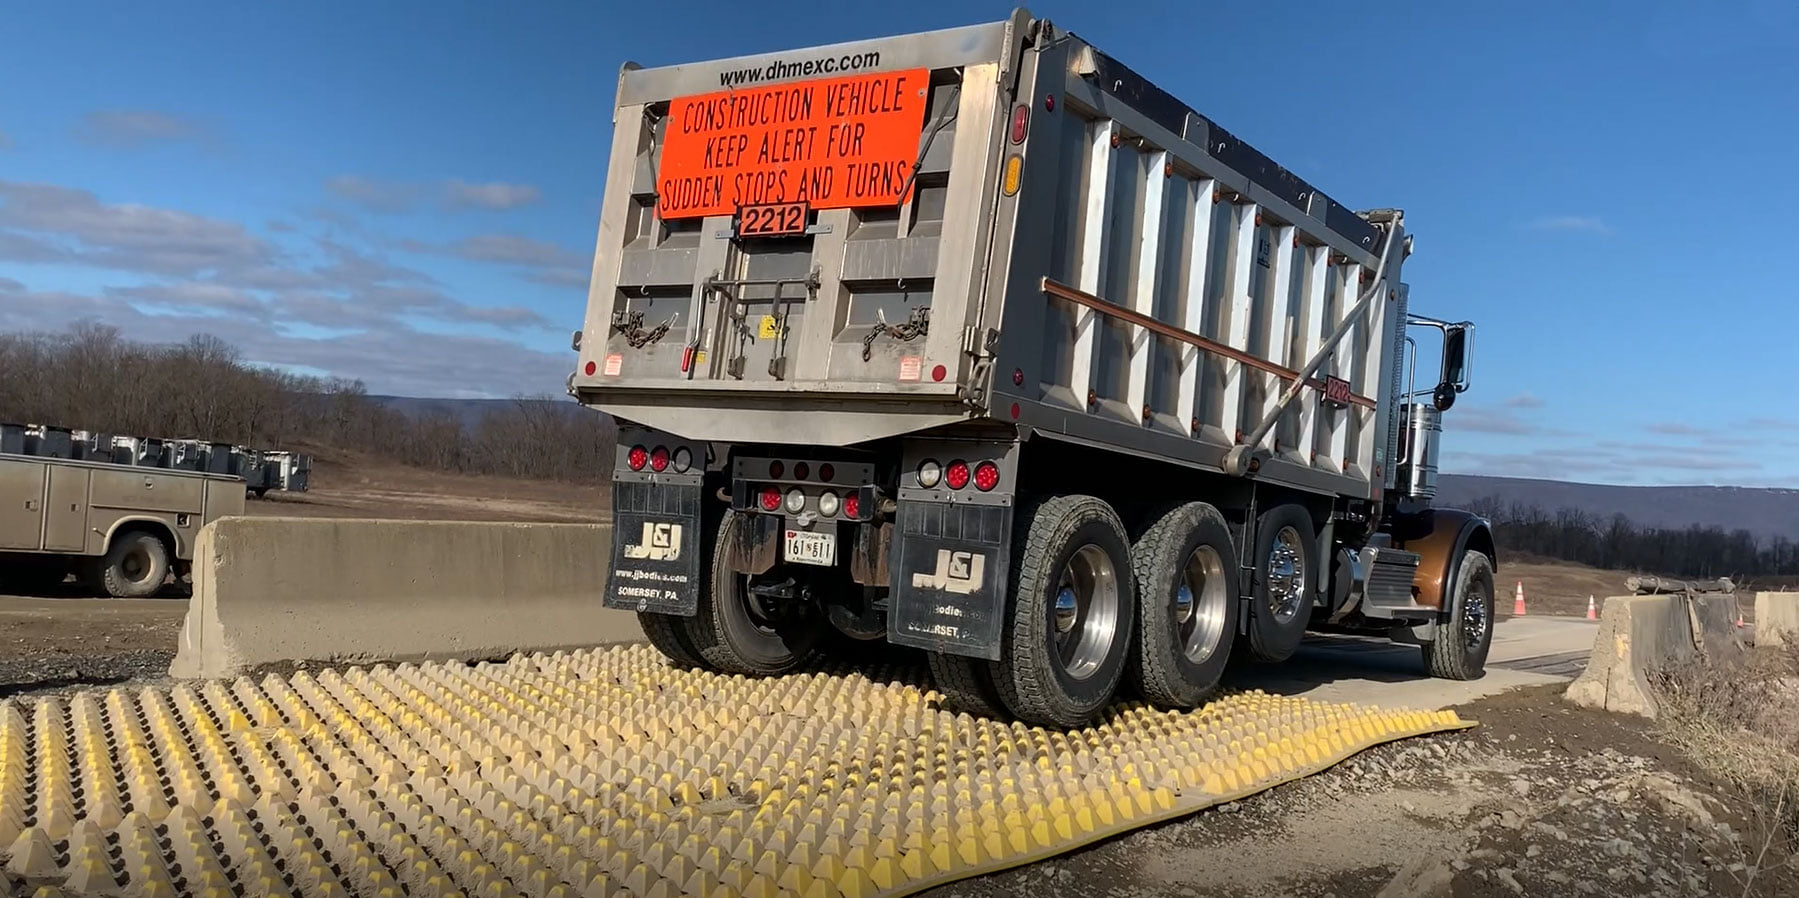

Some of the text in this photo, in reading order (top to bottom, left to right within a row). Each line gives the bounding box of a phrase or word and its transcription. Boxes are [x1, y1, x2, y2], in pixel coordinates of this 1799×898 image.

[719, 51, 880, 86] www.dhmexc.com
[683, 77, 906, 134] CONSTRUCTION VEHICLE
[704, 123, 865, 169] KEEP ALERT FOR
[661, 160, 906, 212] SUDDEN STOPS AND TURNS
[743, 206, 801, 234] 2212
